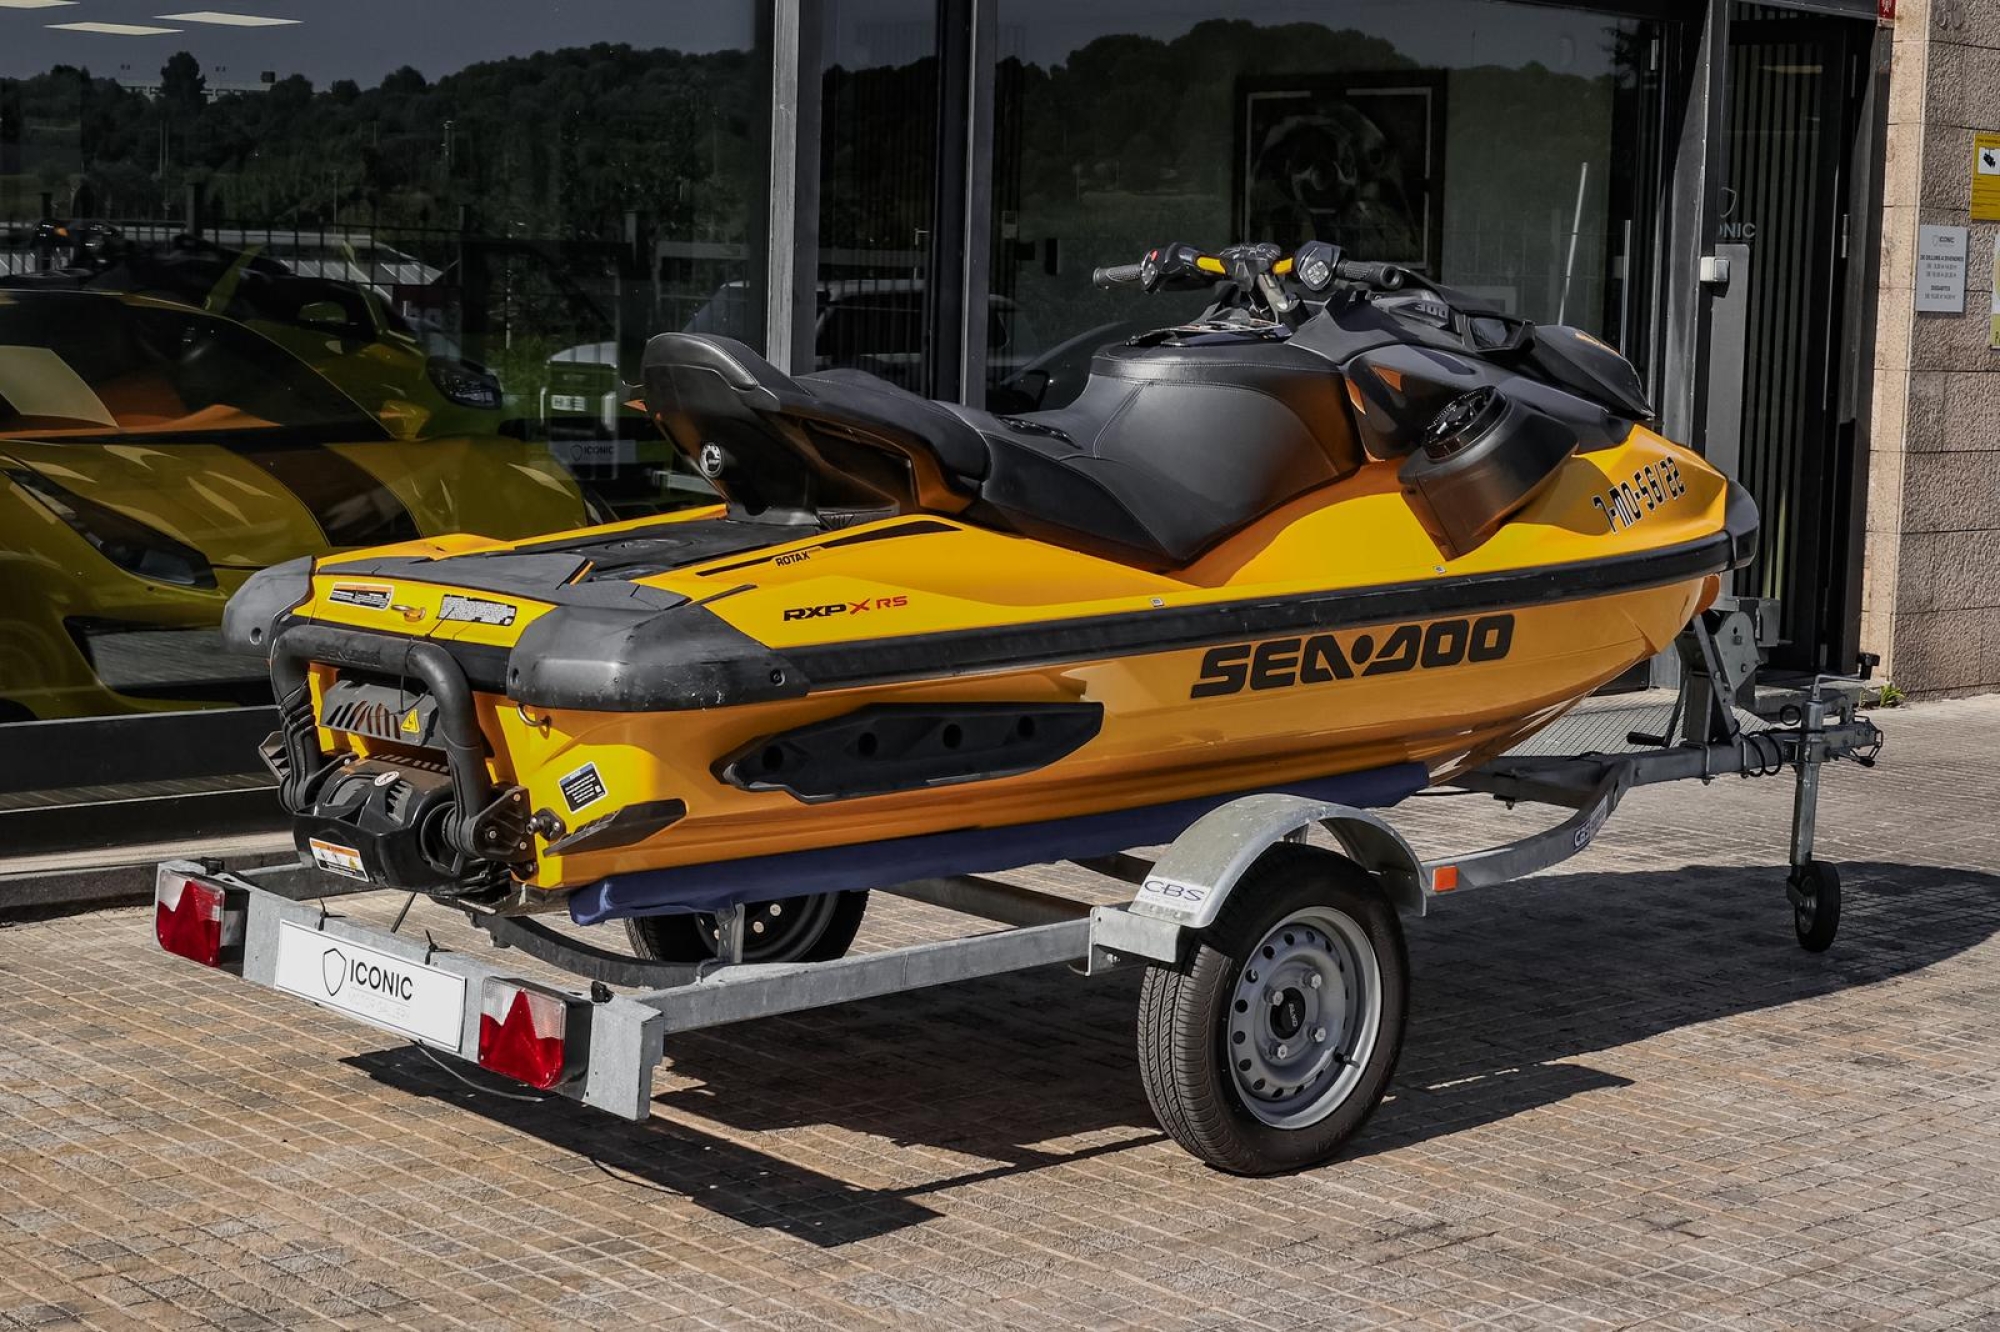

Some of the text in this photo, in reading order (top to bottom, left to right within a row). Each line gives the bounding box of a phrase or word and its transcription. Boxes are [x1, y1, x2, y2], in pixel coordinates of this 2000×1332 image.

[1720, 222, 1756, 238] NIC
[775, 551, 811, 567] ROTAX
[783, 604, 847, 621] RXP
[876, 595, 908, 610] RS
[1144, 880, 1205, 902] CBS
[350, 958, 413, 1000] ICONIC
